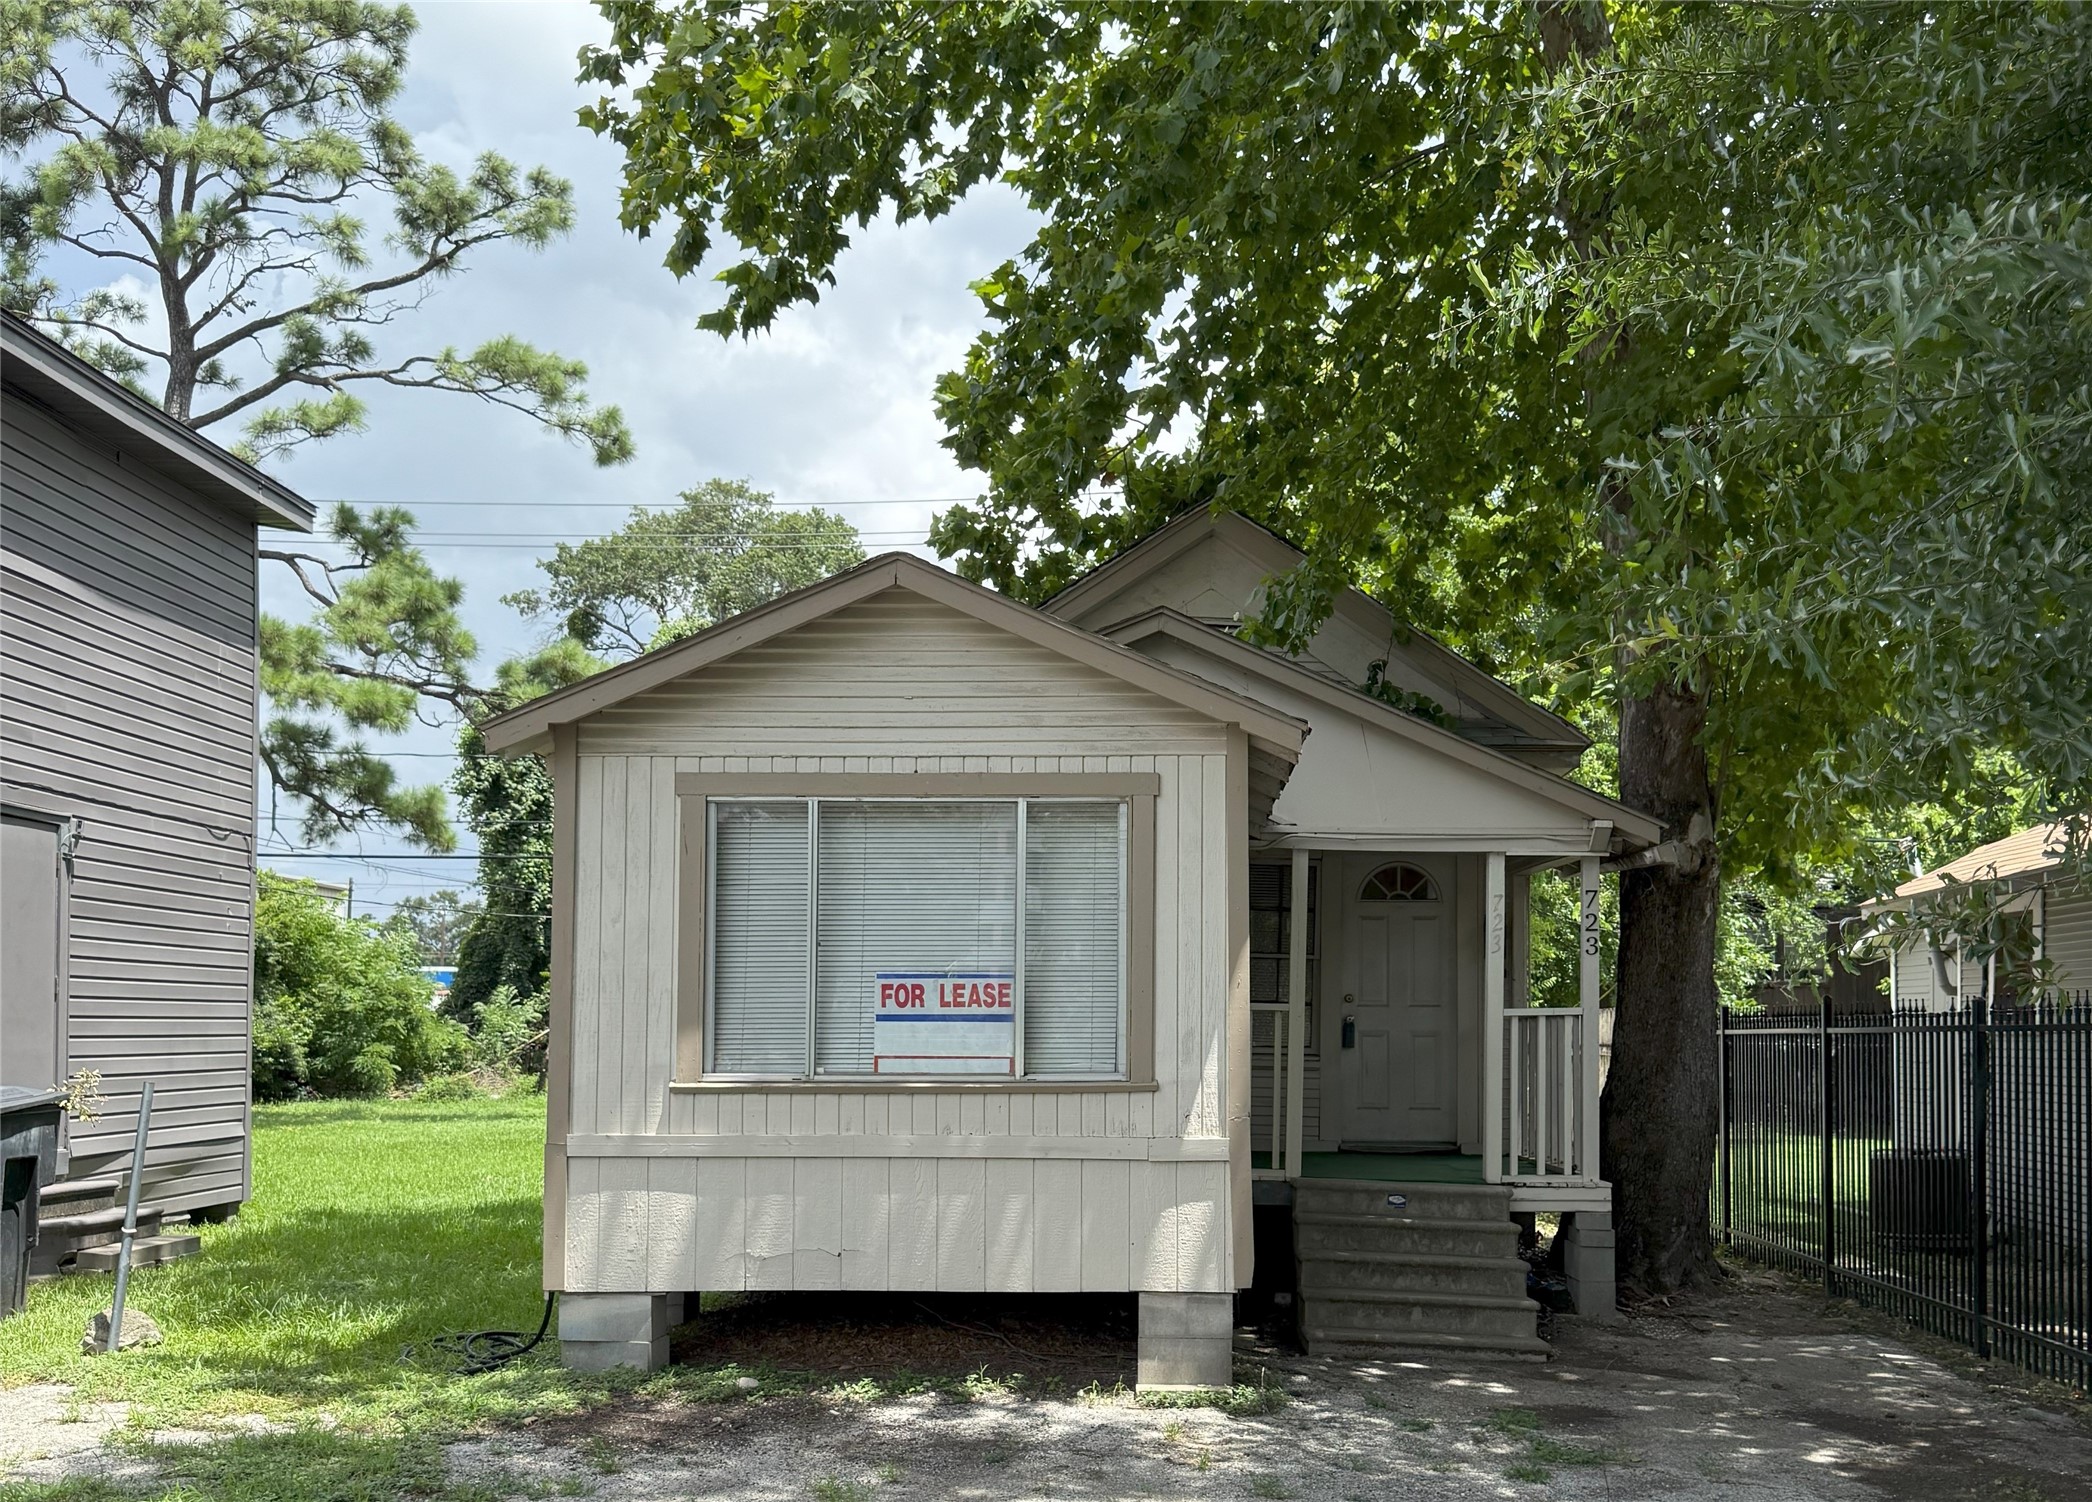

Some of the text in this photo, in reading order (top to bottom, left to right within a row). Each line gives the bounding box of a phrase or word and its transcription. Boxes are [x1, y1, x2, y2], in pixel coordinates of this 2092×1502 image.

[1491, 894, 1504, 954] 723
[1585, 890, 1598, 955] 723
[880, 983, 1012, 1008] FOR LEASE
